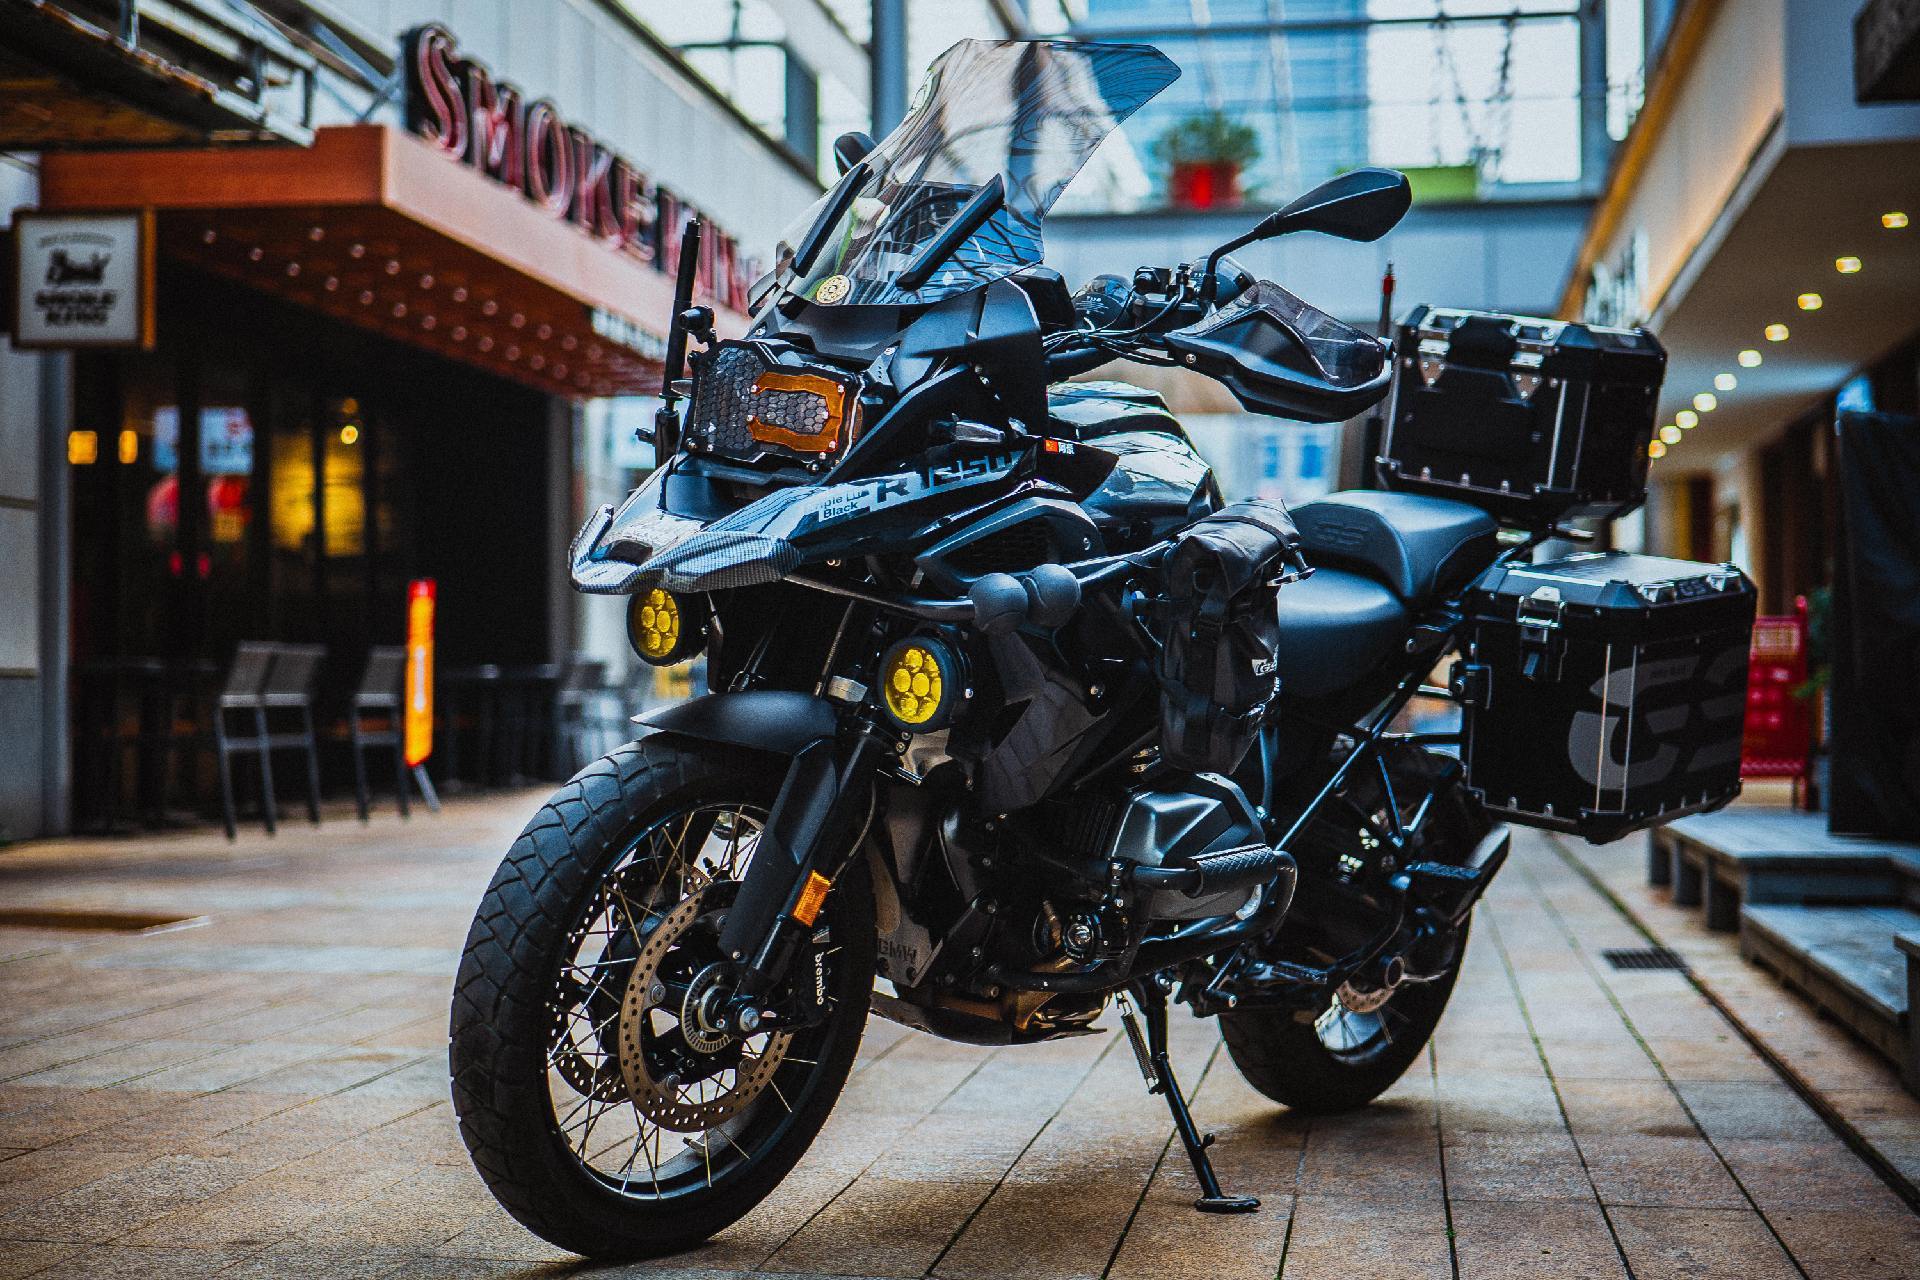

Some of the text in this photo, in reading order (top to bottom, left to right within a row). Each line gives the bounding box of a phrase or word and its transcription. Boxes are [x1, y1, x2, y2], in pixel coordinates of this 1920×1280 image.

[403, 22, 657, 262] SMOKE
[823, 501, 859, 520] Black
[814, 951, 826, 1006] brembo
